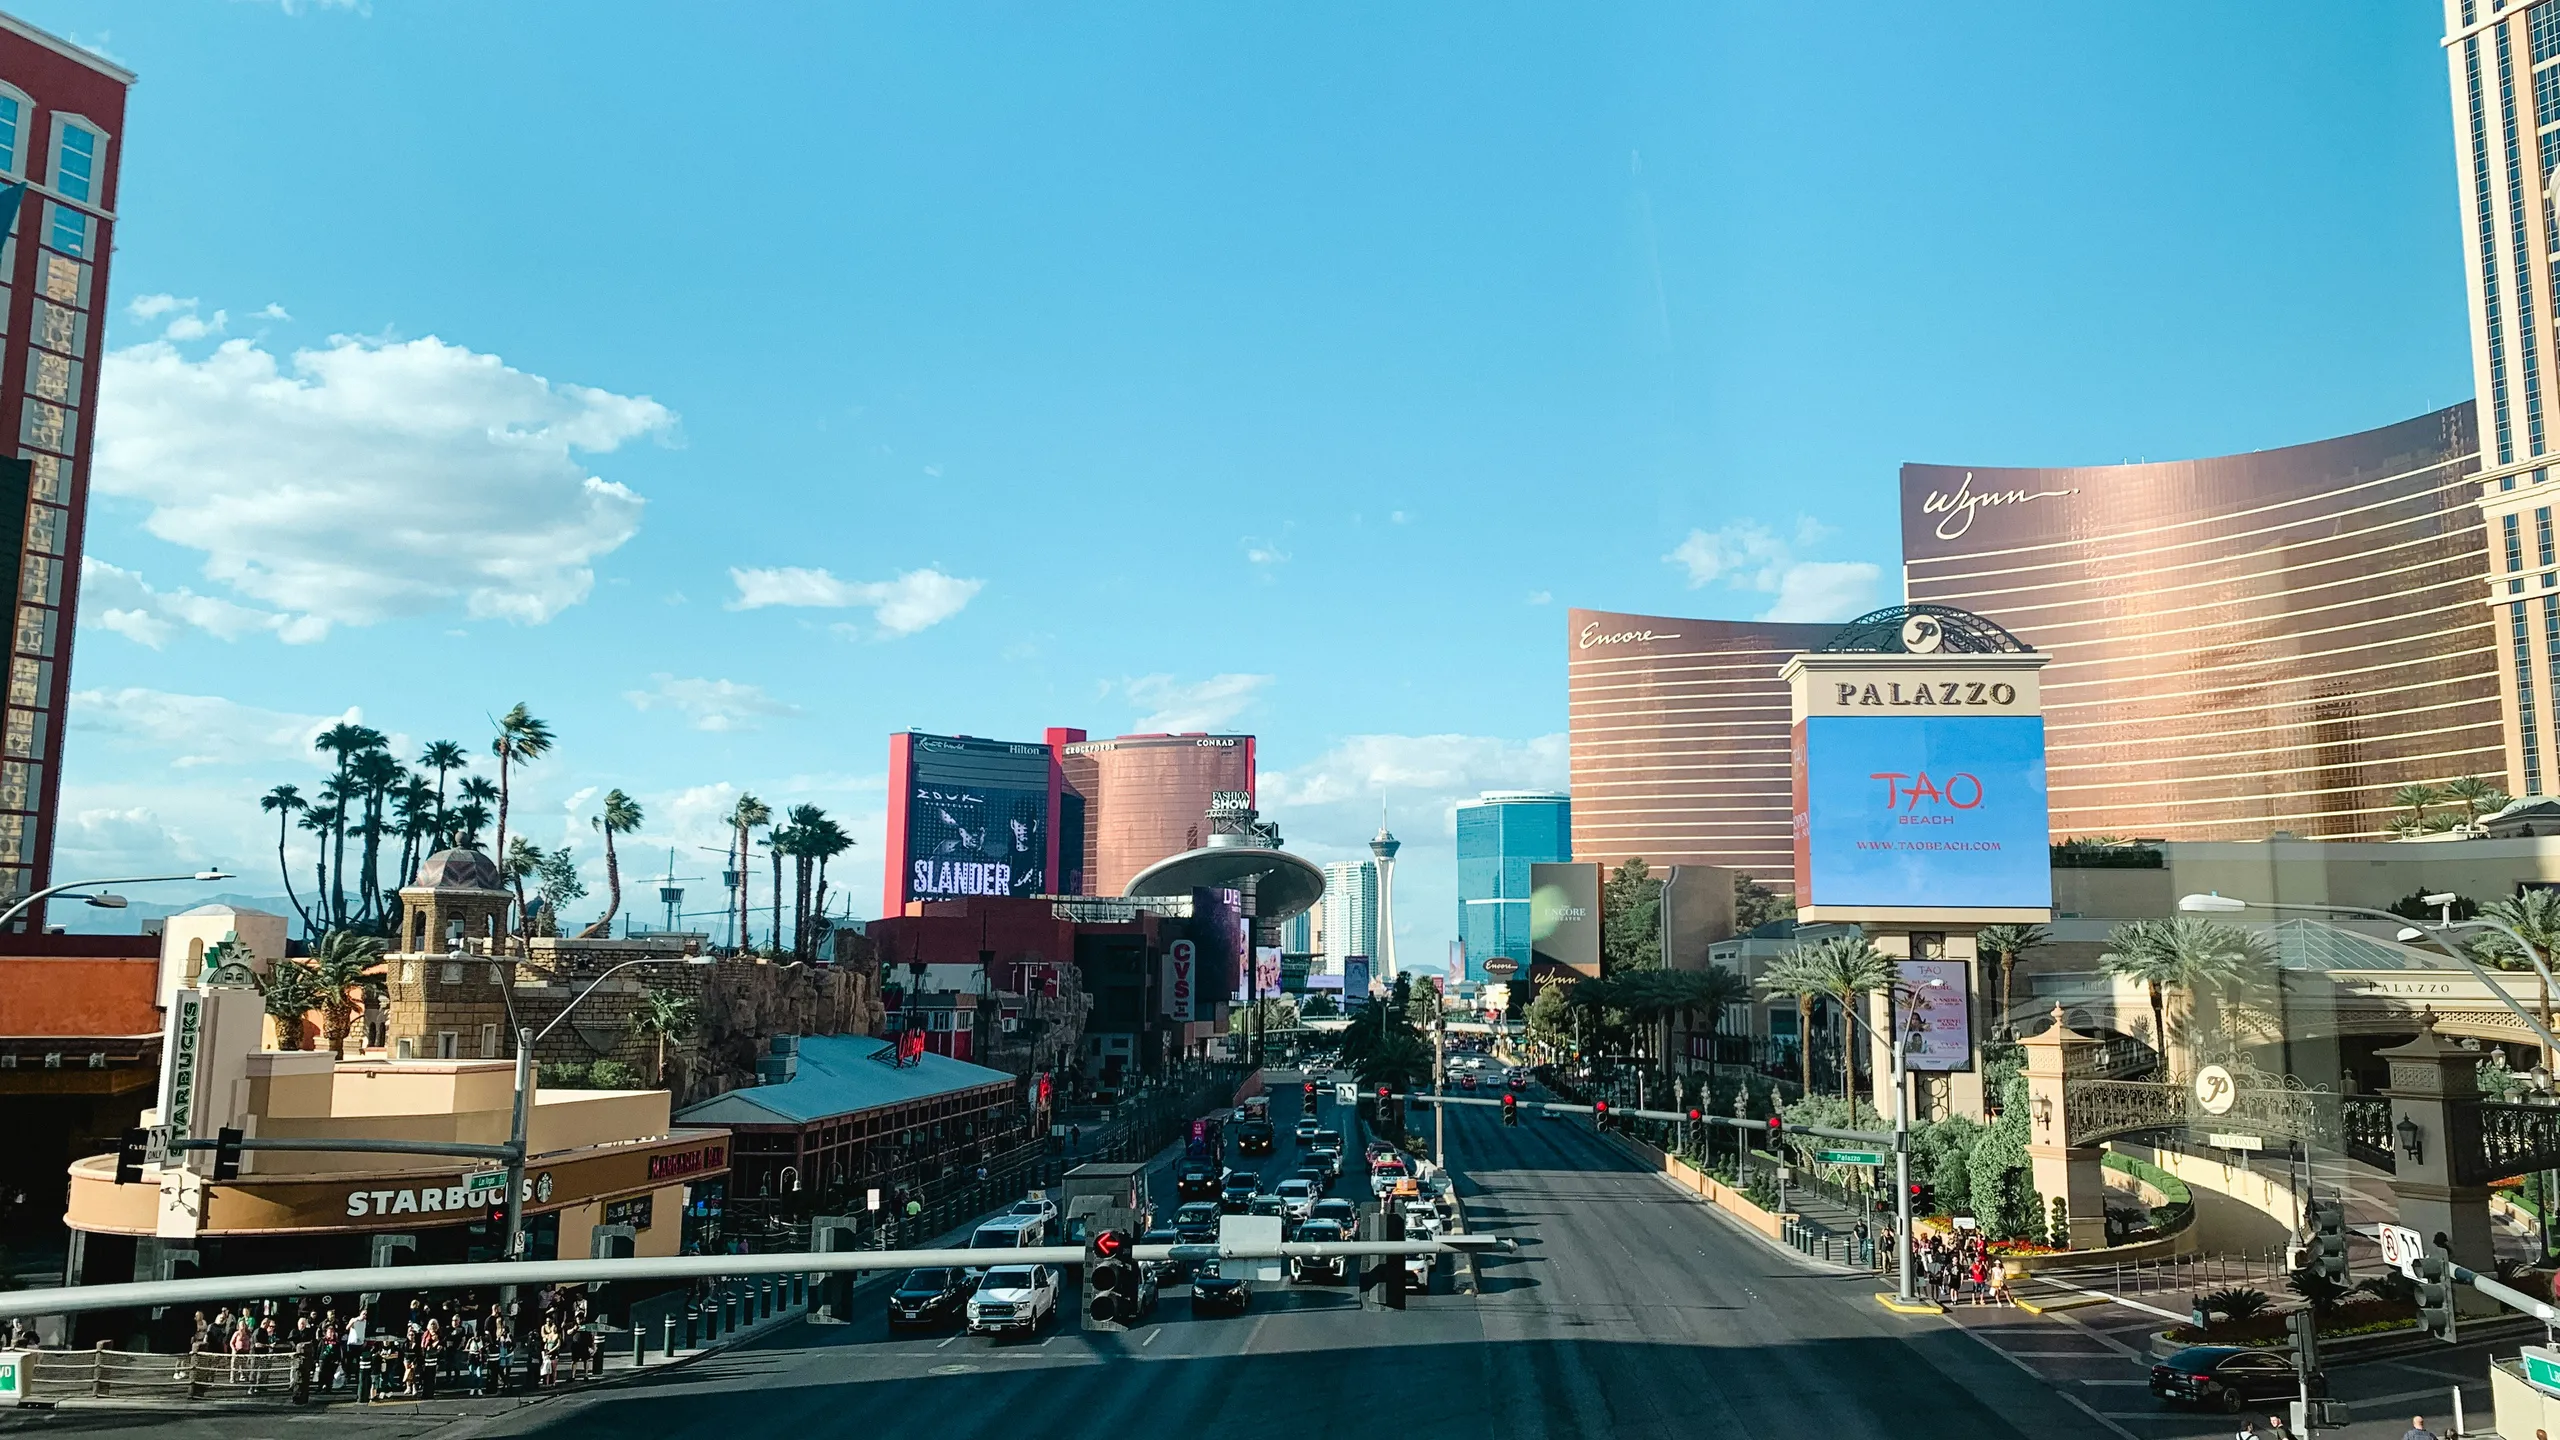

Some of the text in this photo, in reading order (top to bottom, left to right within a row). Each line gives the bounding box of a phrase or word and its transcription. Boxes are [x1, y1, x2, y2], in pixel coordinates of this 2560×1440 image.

[1923, 471, 2080, 540] Wynn
[1579, 621, 1681, 649] Encore
[1835, 681, 2016, 706] PALAZZO
[1197, 739, 1235, 747] CONRAD
[1009, 744, 1040, 755] Hilton
[1212, 791, 1251, 800] FASHION
[1870, 771, 1984, 813] TAO
[1211, 799, 1251, 810] SHOW
[1899, 815, 1954, 825] BEACH
[1857, 841, 2001, 852] WWW.TAOBEACH.COM
[913, 859, 1011, 896] SLANDER
[1174, 943, 1191, 998] CVS
[1485, 960, 1518, 970] Encore
[1917, 965, 1942, 975] TAO
[1534, 967, 1578, 995] Wynn
[2369, 981, 2450, 994] PALAZZO
[170, 1001, 198, 1158] STARBUCKS
[2212, 1136, 2259, 1147] EXIT ONLY
[148, 1150, 162, 1160] ONLY
[347, 1178, 533, 1217] STARBUCS
